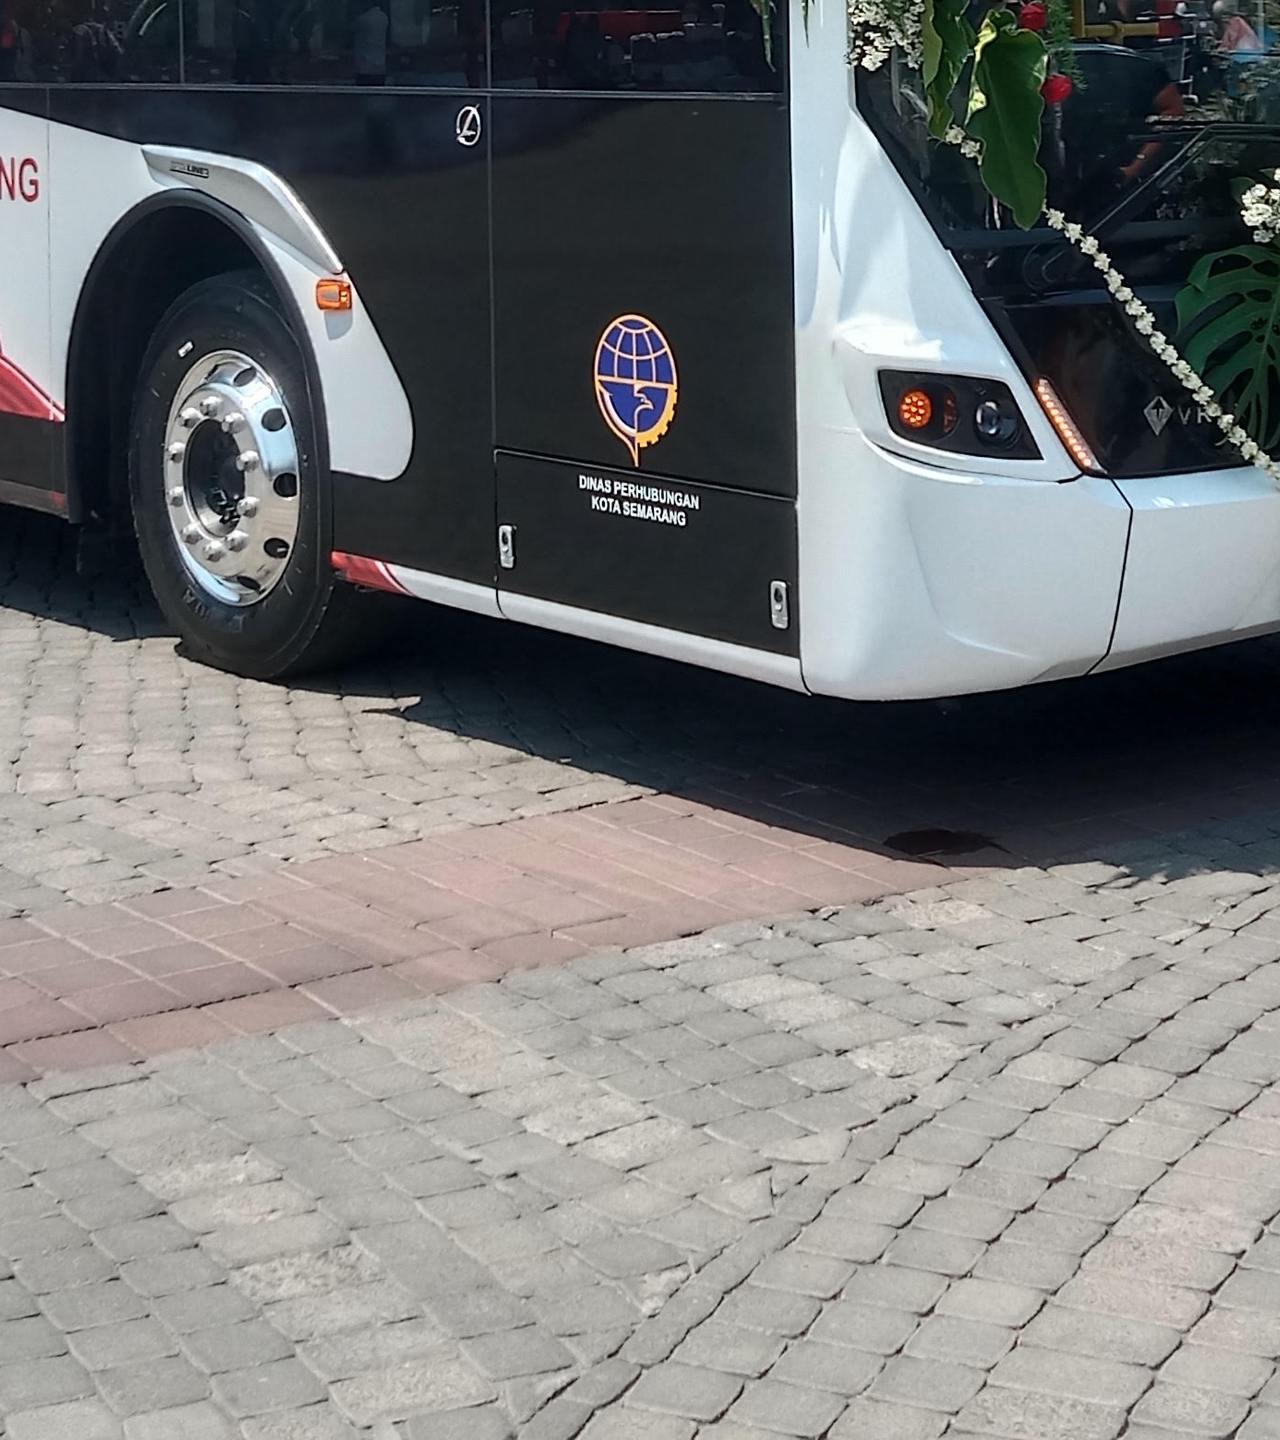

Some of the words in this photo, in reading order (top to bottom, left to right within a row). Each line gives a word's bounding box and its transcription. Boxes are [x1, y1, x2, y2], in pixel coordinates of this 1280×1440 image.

[578, 474, 612, 494] DINAS
[613, 481, 700, 510] PERHUBUNGAN
[591, 495, 622, 515] KOTA
[622, 501, 687, 527] SEMARANG
